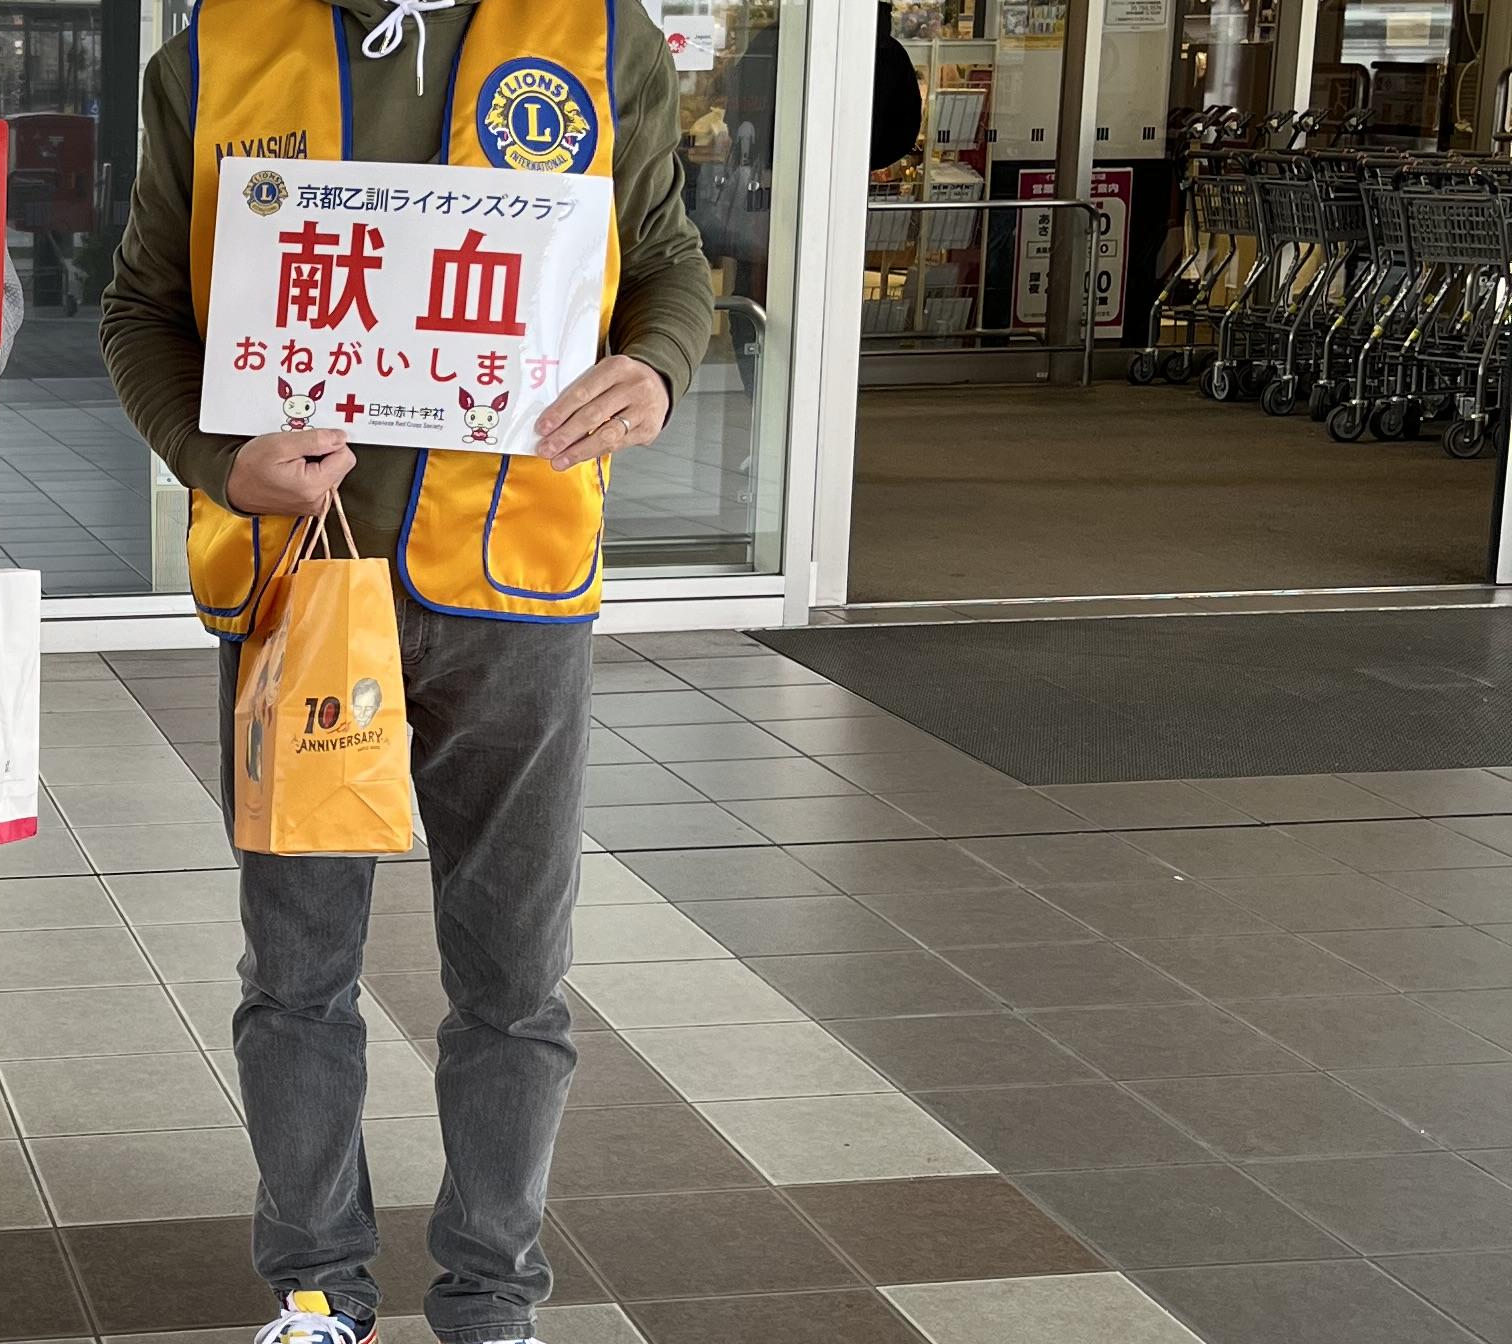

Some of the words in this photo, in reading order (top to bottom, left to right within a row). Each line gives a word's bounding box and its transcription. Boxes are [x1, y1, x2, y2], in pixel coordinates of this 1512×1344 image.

[504, 72, 565, 98] LIONS
[524, 103, 552, 142] L
[261, 185, 273, 201] L
[296, 184, 580, 220] 京都乙訓ライオンズクラブ
[275, 220, 527, 336] 献血
[233, 336, 560, 389] おねがいします
[369, 403, 445, 421] 日本赤十字社
[304, 696, 341, 734] 10
[295, 728, 384, 754] ANNIVERSARY
